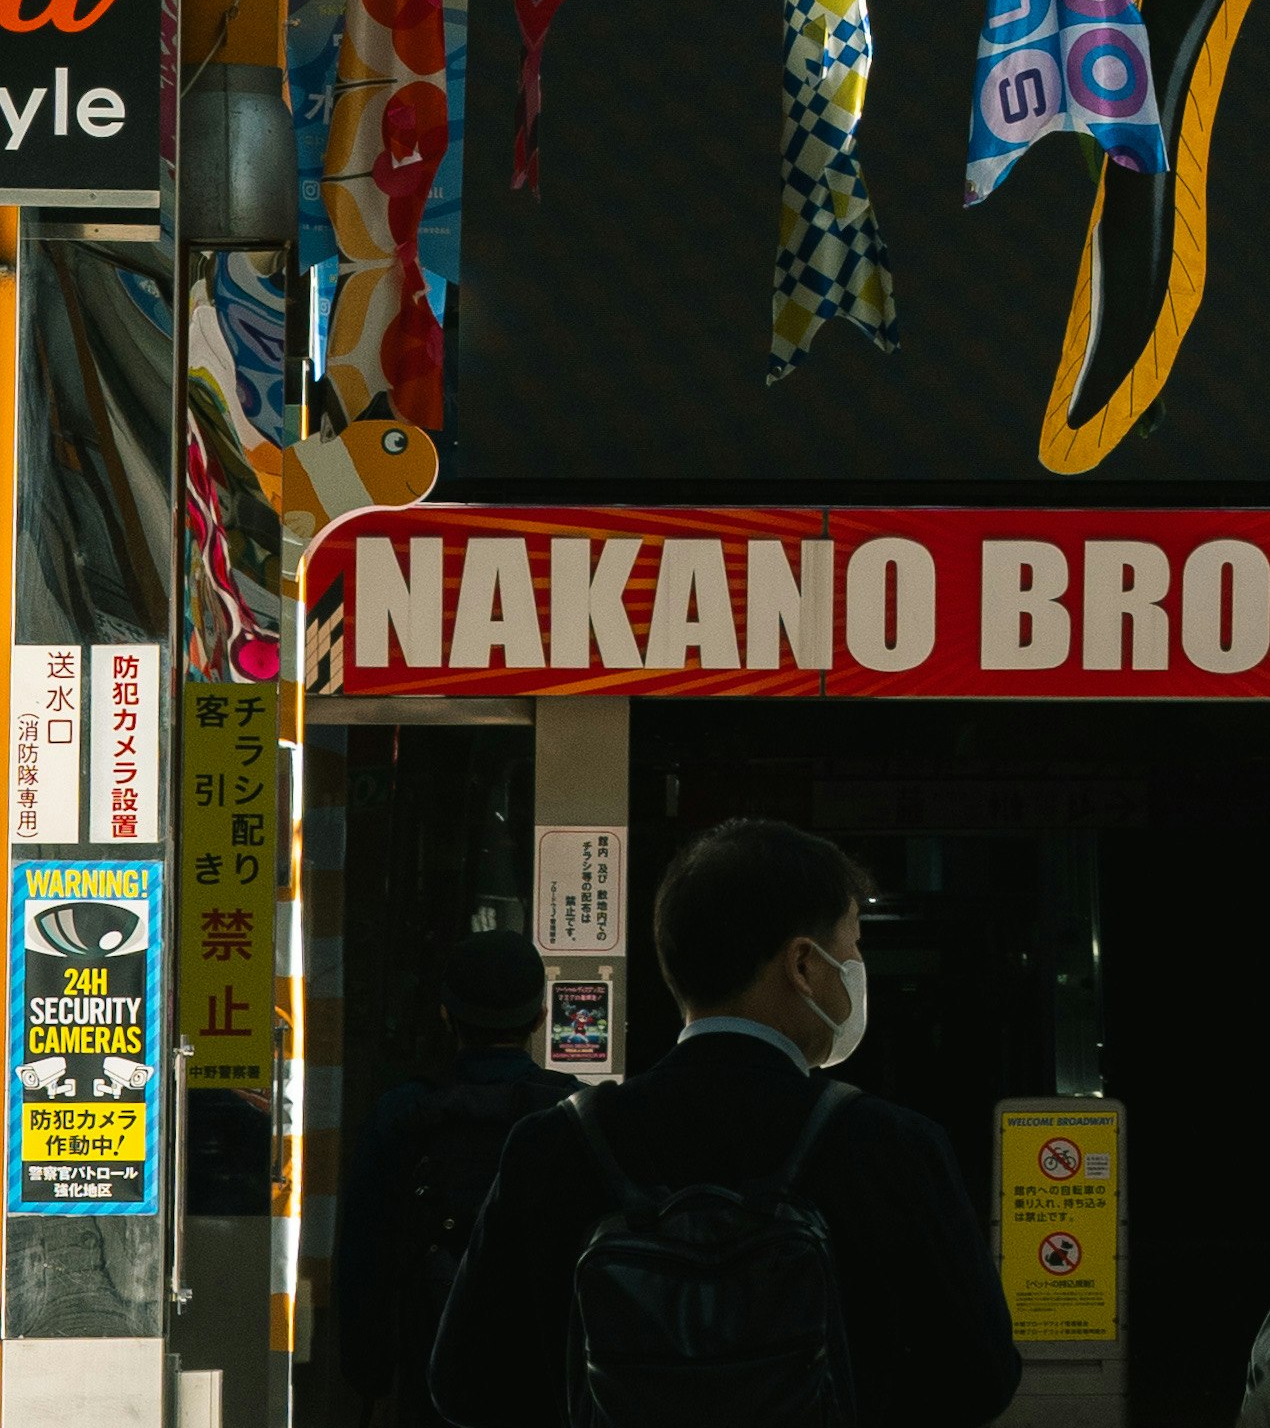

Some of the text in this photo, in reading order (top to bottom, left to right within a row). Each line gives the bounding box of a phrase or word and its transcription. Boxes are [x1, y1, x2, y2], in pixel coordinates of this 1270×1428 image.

[355, 538, 936, 672] NAKANO
[45, 651, 76, 744] 送水口
[111, 654, 140, 839] 防犯カメラ設置
[16, 713, 40, 838] (消防隊専用)
[195, 694, 230, 886] 客引き
[231, 697, 266, 886] チラシ配り
[26, 869, 149, 899] WARNING!
[63, 968, 108, 997] 24H
[200, 907, 254, 1037] 禁止
[29, 997, 142, 1025] SECURITY
[28, 1026, 142, 1054] CAMERAS
[188, 1065, 261, 1081] 中野警察署
[30, 1109, 138, 1131] 防犯カメラ
[1007, 1116, 1114, 1127] WELCOME BROADWAY!
[45, 1135, 126, 1157] 作動中!
[28, 1166, 138, 1182] 警察官パトロール
[53, 1182, 113, 1199] 強化地区
[1013, 1185, 1106, 1196] 館内への自転車の
[1014, 1211, 1074, 1223] は禁止です。
